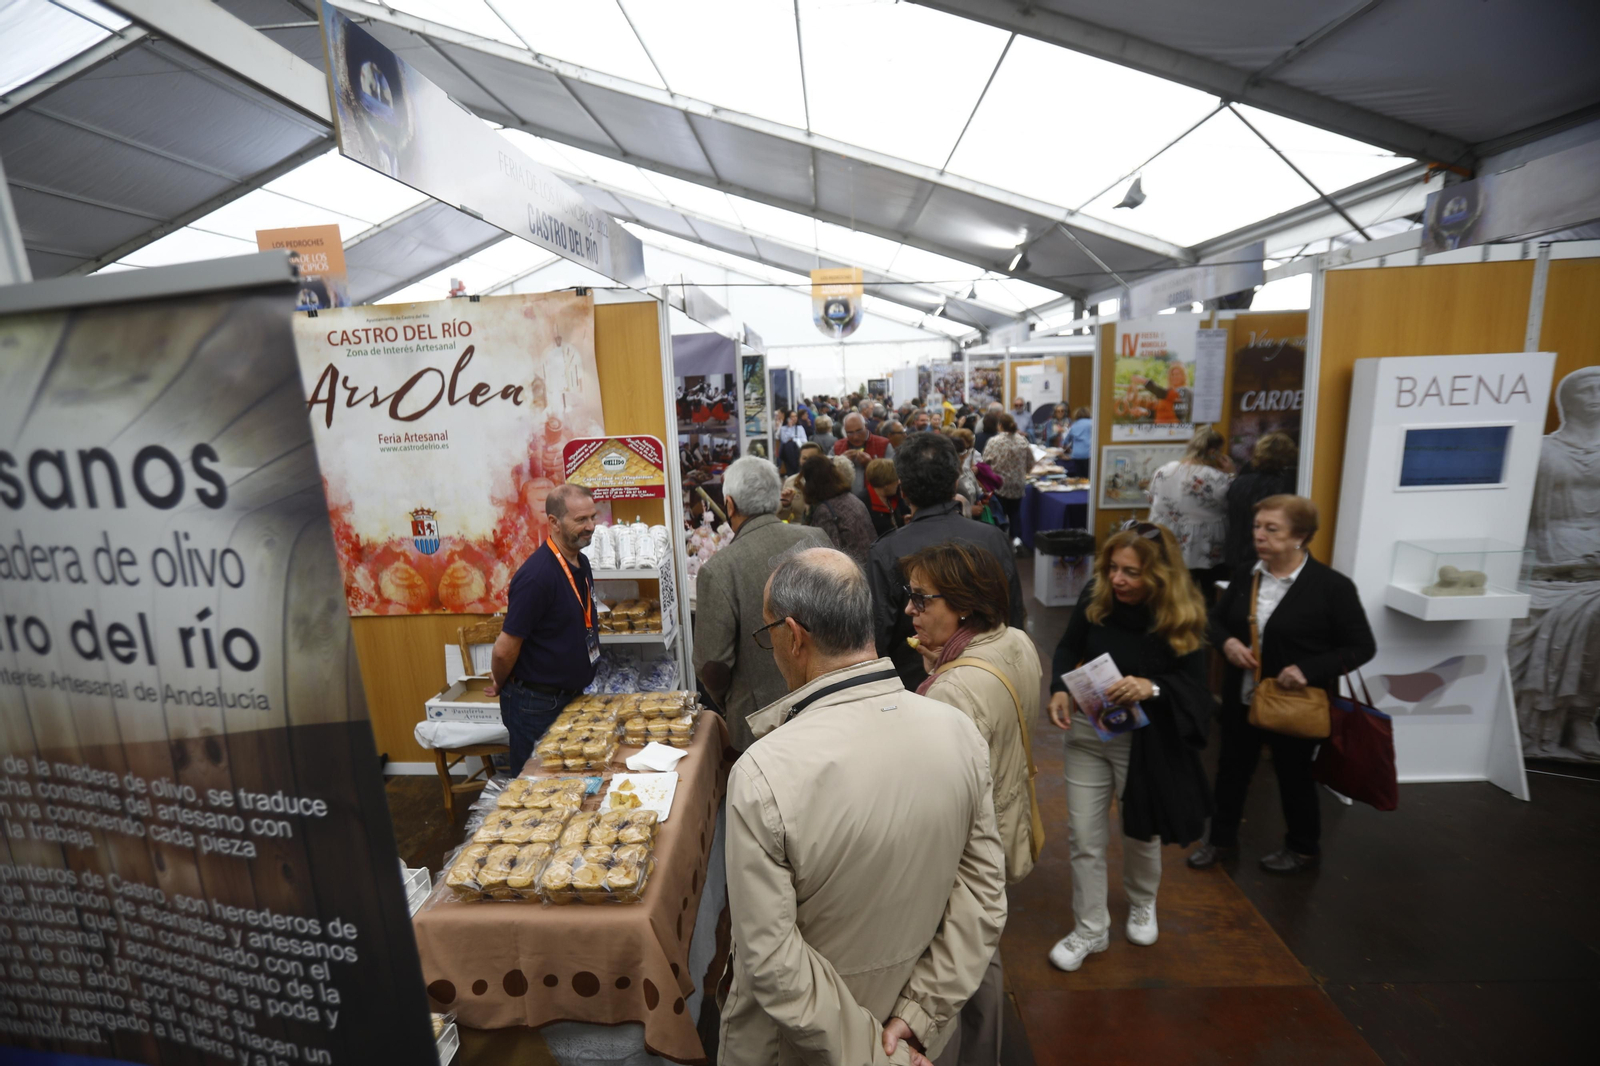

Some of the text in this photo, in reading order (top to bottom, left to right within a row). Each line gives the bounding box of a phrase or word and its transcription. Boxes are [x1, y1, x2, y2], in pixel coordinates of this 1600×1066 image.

[498, 150, 525, 187] FERIA
[272, 238, 324, 249] LOS PEDROCHES
[312, 252, 327, 262] LOS
[527, 202, 599, 265] CASTRO DEL RÍO
[327, 318, 472, 347] CASTRO DEL RÍO
[346, 341, 456, 358] Zona de Interés Artesanal
[1122, 333, 1139, 357] IV
[1394, 373, 1532, 408] BAENA
[378, 430, 448, 444] Feria Artesanal
[380, 442, 449, 453] www.castrodelrio.es
[0, 443, 227, 510] sanos
[93, 531, 140, 586] de
[152, 531, 245, 588] olivo
[70, 609, 156, 666] del
[178, 607, 260, 672] río
[50, 670, 129, 699] Artesanal
[133, 682, 157, 702] de
[163, 684, 271, 711] Andalucía
[4, 754, 29, 774] de
[32, 756, 51, 776] la
[54, 762, 120, 788] madera
[123, 771, 147, 793] de
[207, 788, 234, 807] se
[238, 788, 328, 817] traduce
[37, 782, 122, 811] constante
[125, 793, 153, 817] del
[157, 804, 245, 833] artesano
[250, 817, 293, 838] con
[6, 819, 25, 839] la
[17, 802, 42, 819] va
[47, 804, 146, 837] conociendo
[149, 824, 196, 848] cada
[200, 831, 257, 858] pieza
[29, 883, 111, 911] tradición
[114, 896, 137, 917] de
[140, 903, 226, 940] ebanistas
[230, 927, 242, 948] y
[248, 931, 358, 963] artesanos
[81, 869, 105, 890] de
[174, 894, 210, 915] son
[212, 898, 322, 935] herederos
[327, 917, 358, 940] de
[17, 925, 106, 948] artesanal
[110, 937, 120, 956] y
[126, 940, 280, 993] aprovechamiento
[287, 979, 314, 1000] de
[320, 983, 341, 1004] la
[84, 912, 118, 932] que
[121, 915, 155, 941] han
[159, 929, 259, 969] continuado
[265, 956, 304, 977] con
[310, 961, 331, 981] el
[11, 961, 34, 980] de
[39, 966, 81, 984] este
[142, 982, 170, 999] por
[173, 988, 190, 1008] lo
[194, 998, 228, 1020] que
[232, 1009, 256, 1028] su
[29, 943, 54, 962] de
[115, 957, 211, 996] procedente
[215, 983, 239, 1004] de
[242, 988, 261, 1010] la
[266, 998, 320, 1022] poda
[325, 1009, 339, 1030] y
[23, 1002, 62, 1024] muy
[69, 1007, 149, 1033] apegado
[155, 1022, 166, 1037] a
[170, 1021, 187, 1043] la
[130, 998, 151, 1015] es
[154, 1001, 177, 1021] tal
[181, 1012, 214, 1034] que
[217, 1020, 234, 1041] lo
[238, 1026, 299, 1059] hacen
[305, 1047, 331, 1065] un
